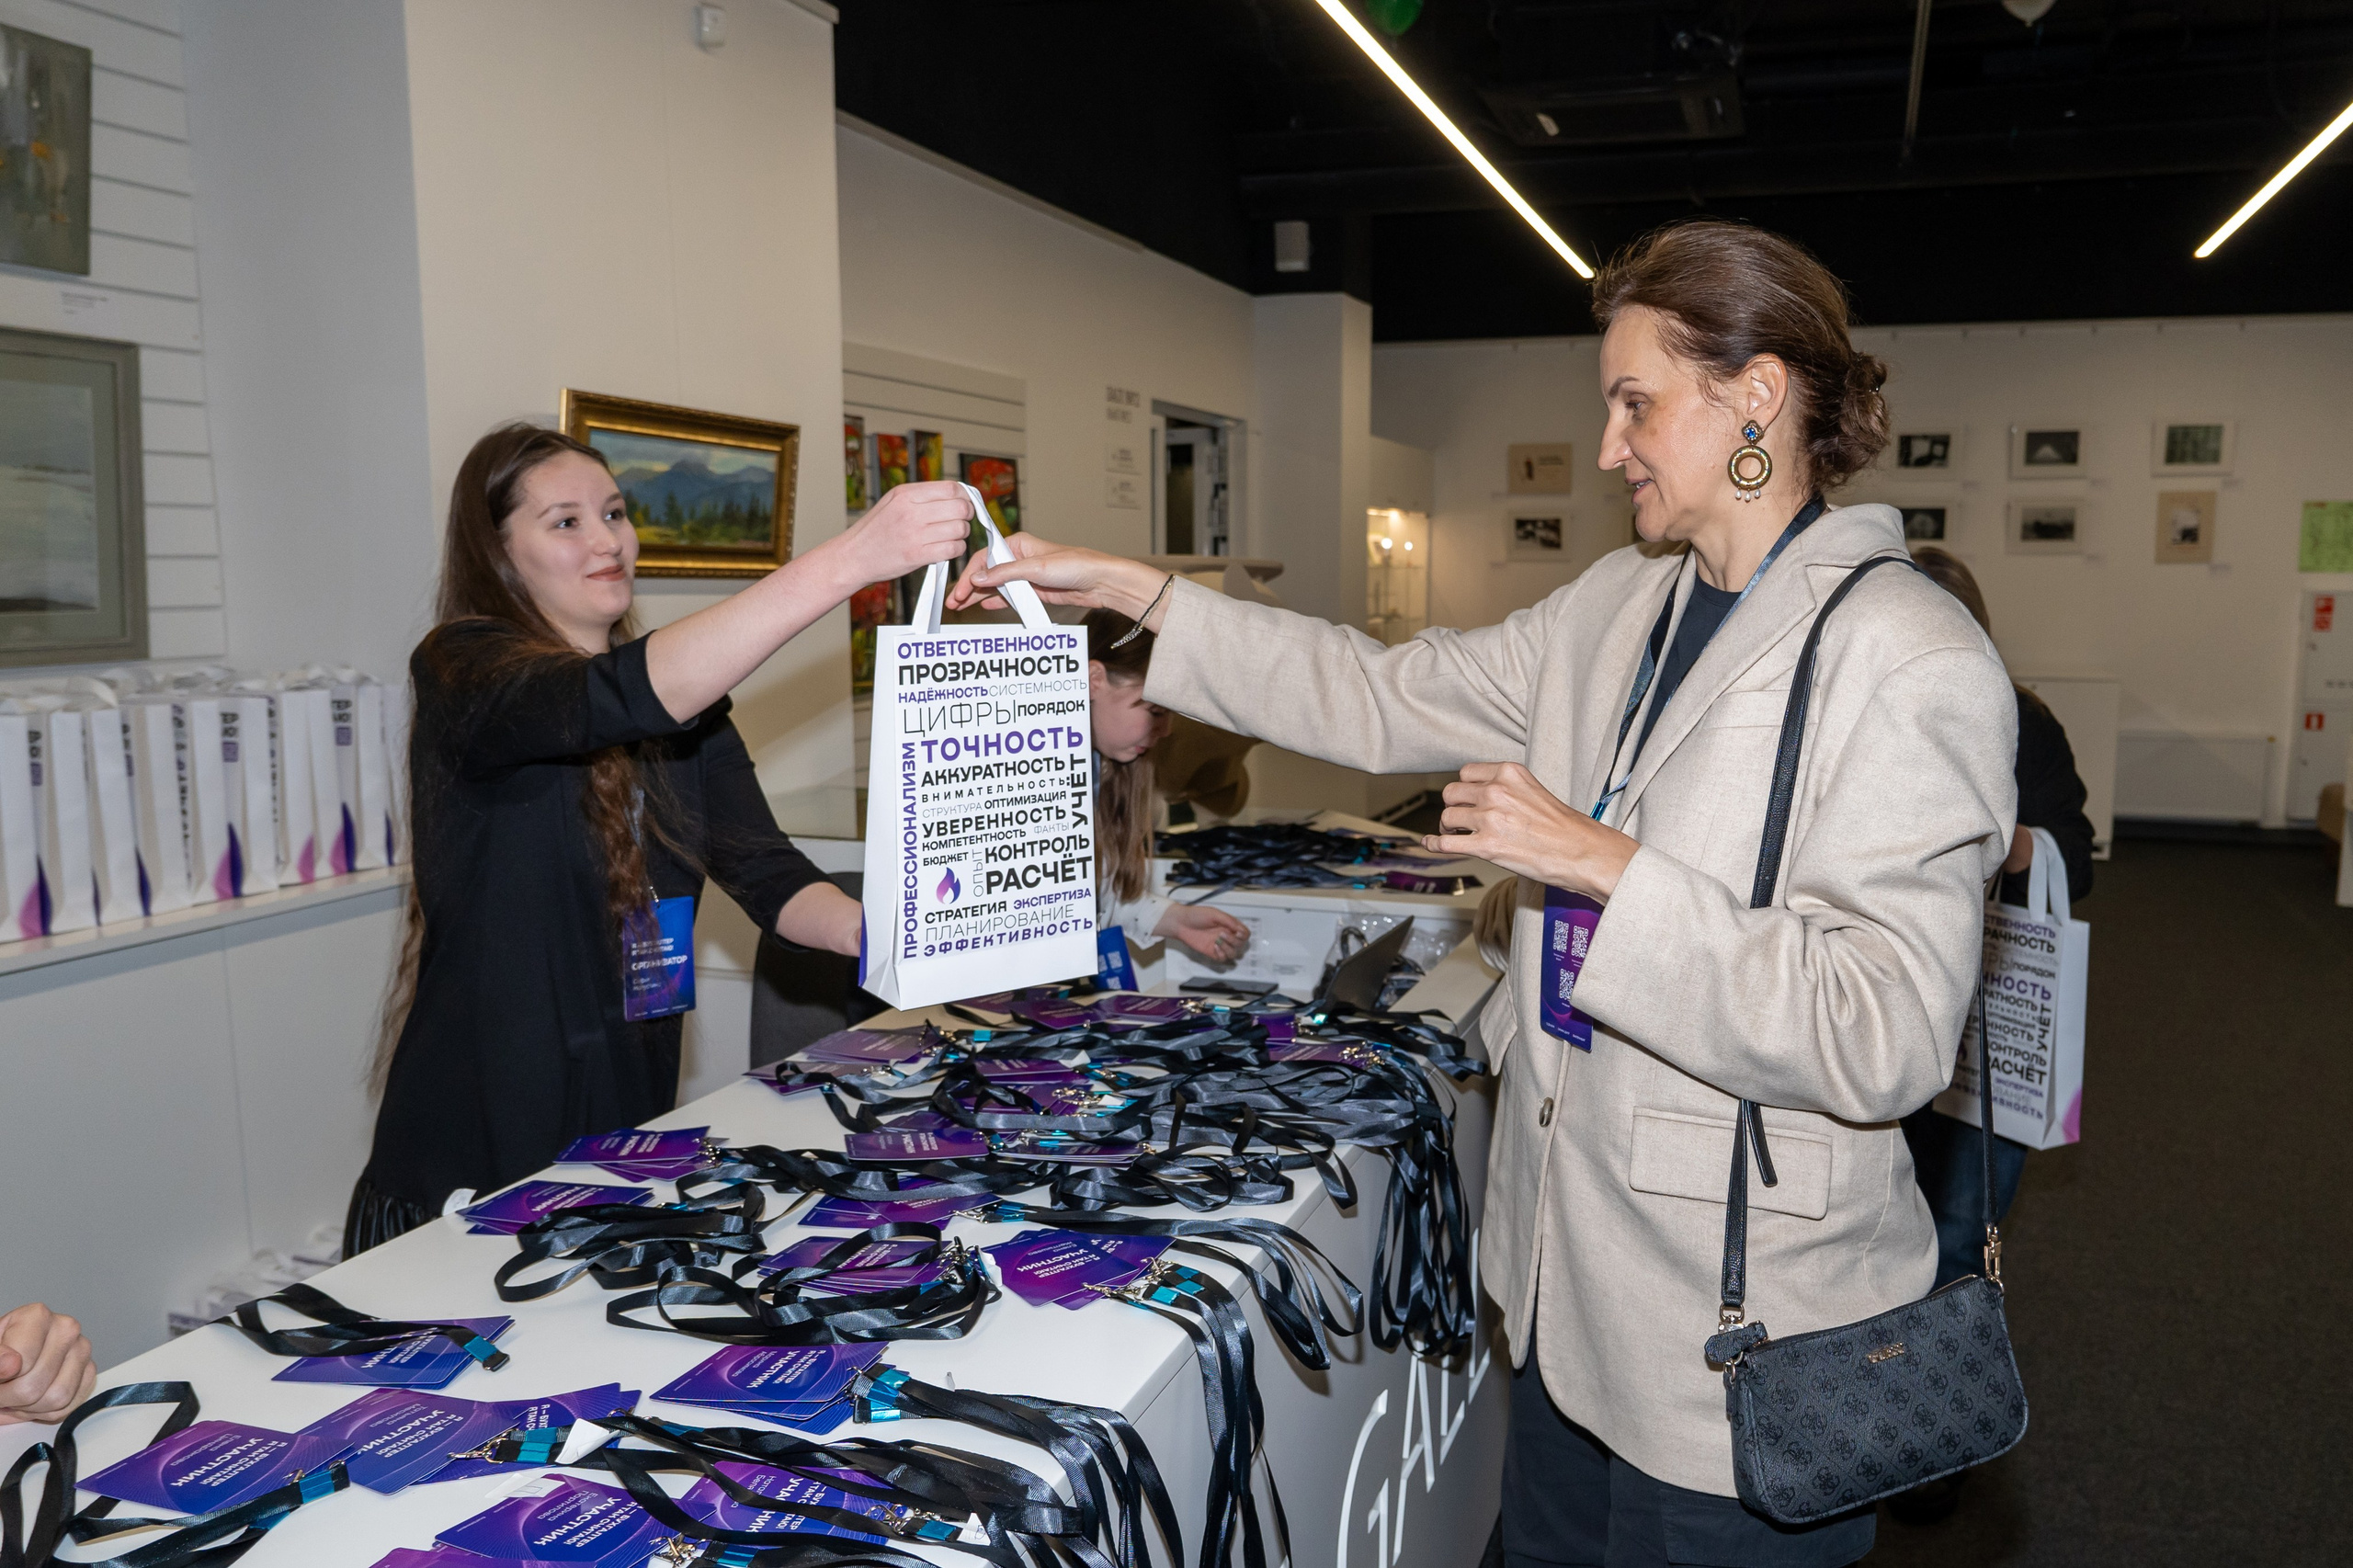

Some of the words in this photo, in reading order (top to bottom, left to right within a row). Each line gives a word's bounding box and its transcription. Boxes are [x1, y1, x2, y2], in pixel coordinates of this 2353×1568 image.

[897, 634, 1078, 660] ОТВЕТСТВЕННОСТЬ
[898, 654, 1080, 686] ПРОЗРАЧНОСТЬ
[898, 687, 988, 704] НАДЁЖНОСТЬ
[989, 678, 1087, 697] СИСТЕМНОСТЬ
[904, 699, 1017, 737] ЦИФРЫ
[1017, 699, 1085, 717] ПОРЯДОК
[921, 726, 1084, 764] ТОЧНОСТЬ
[921, 756, 1065, 788] АККУРАТНОСТЬ
[922, 777, 1065, 803] ВНИМАТЕЛЬНОСТЬ
[922, 802, 983, 819] СТРУКТУРА
[984, 790, 1066, 810] ОПТИМИЗАЦИЯ
[922, 805, 1066, 838] УВЕРЕННОСТЬ
[922, 829, 1027, 852] КОМПЕТЕНТНОСТЬ
[1033, 823, 1070, 835] ФАКТЫ
[902, 742, 918, 959] ПРОФЕССИОНАЛИЗМ
[923, 852, 969, 867] БЮДЖЕТ
[985, 834, 1090, 864] КОНТРОЛЬ
[972, 849, 983, 898] ОПЫТ
[986, 853, 1093, 895] РАСЧЁТ
[925, 901, 1007, 925] СТРАТЕГИЯ
[1013, 888, 1092, 910] ЭКСПЕРТИЗА
[924, 918, 1093, 958] ЭФФЕКТИВНОСТЬ
[926, 903, 1074, 943] ПЛАНИРОВАНИЕ
[1984, 926, 2055, 953] РАЧНОСТЬ
[1989, 1040, 2047, 1066] ОНТРОЛЬ
[1015, 1246, 1089, 1272] УЧАСТНИК
[359, 1345, 398, 1369] ТНИК
[745, 1349, 801, 1389] УЧАСТНИК
[424, 1417, 449, 1430] ТАК
[381, 1426, 445, 1458] БУХГАЛТЕР
[169, 1435, 265, 1488] УЧАСТНИК
[209, 1451, 269, 1487] БУХГАЛТЕР
[532, 1494, 622, 1547] УЧАСТНИК
[546, 1491, 598, 1522] Екатерина
[607, 1505, 631, 1519] ТАК
[573, 1513, 631, 1548] БУХГАЛТЕР
